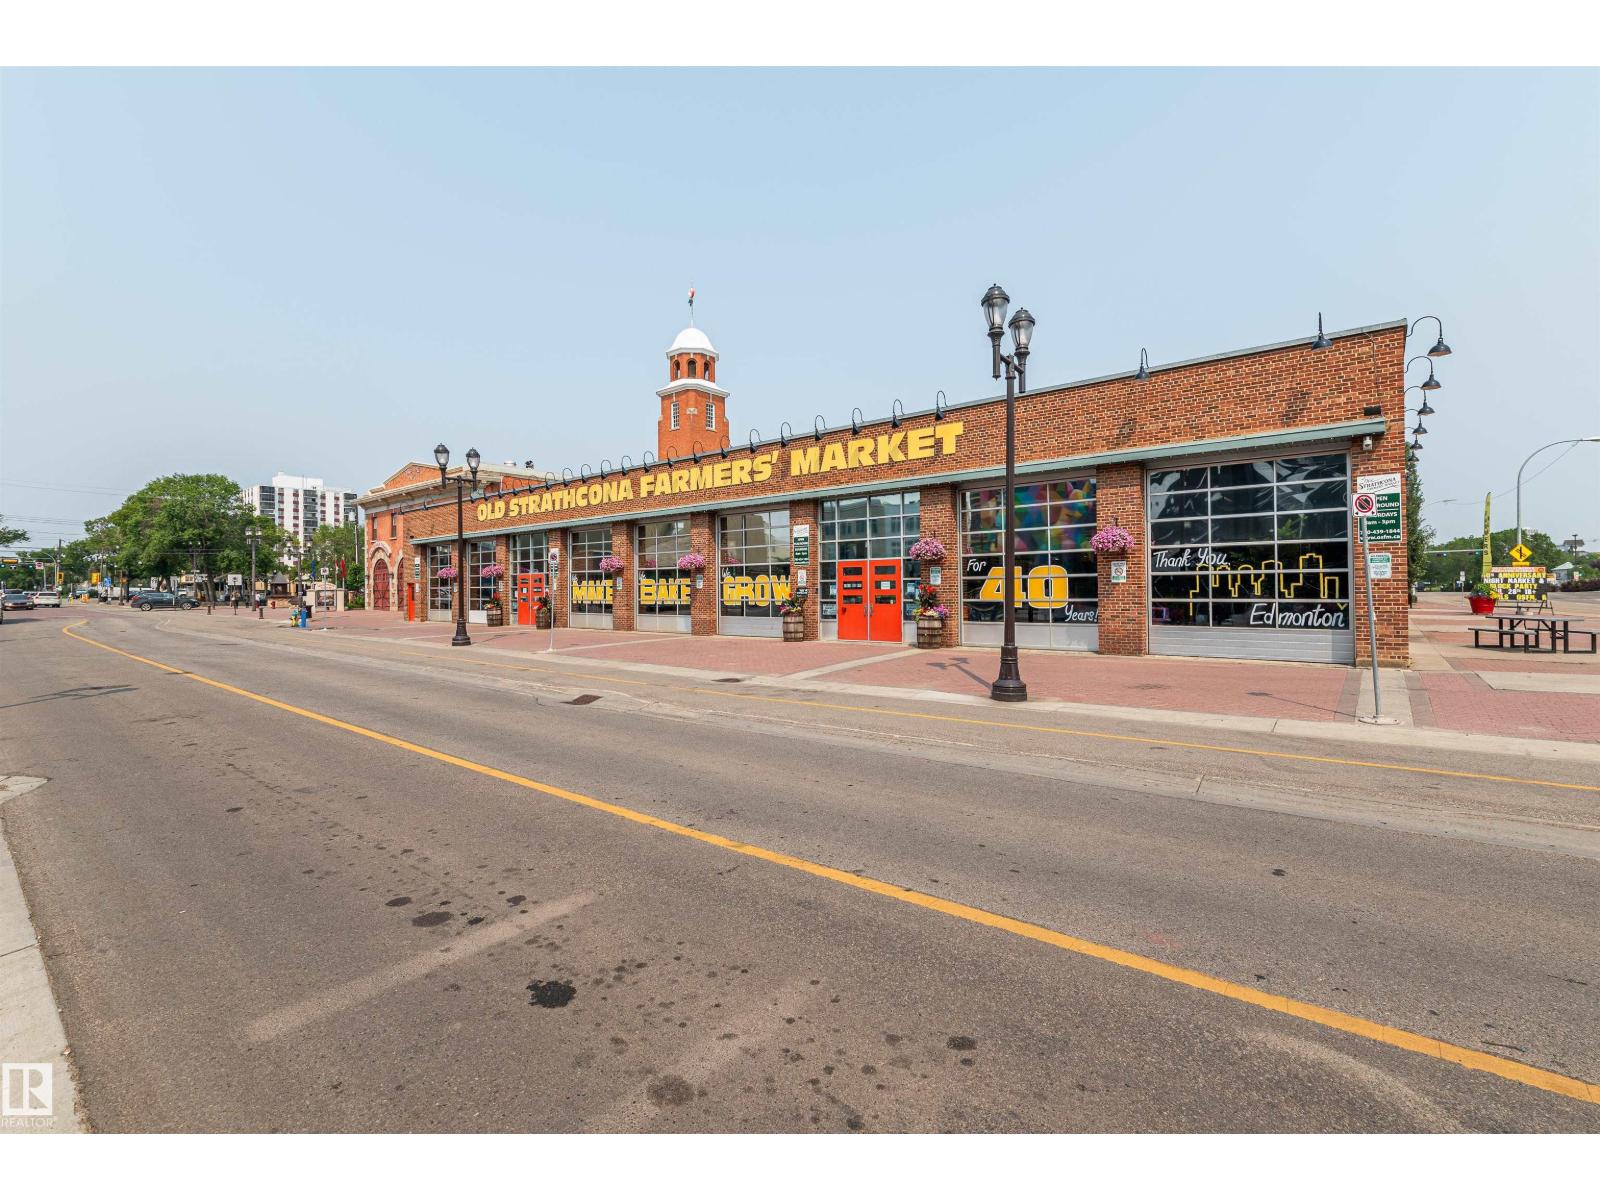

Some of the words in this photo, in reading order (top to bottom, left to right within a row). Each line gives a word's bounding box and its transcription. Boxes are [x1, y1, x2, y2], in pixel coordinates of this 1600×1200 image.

[477, 501, 505, 522] OLD
[509, 479, 634, 517] STRATHCONA
[640, 450, 779, 498] FARMERS'
[790, 421, 964, 477] MARKET
[966, 558, 987, 572] For
[1153, 548, 1191, 568] Thank
[572, 580, 614, 604] MAKE
[640, 578, 691, 605] BAKE
[723, 575, 792, 607] GROW
[980, 565, 1069, 609] 40
[1064, 604, 1099, 623] Years!
[1250, 603, 1345, 628] Edmonton
